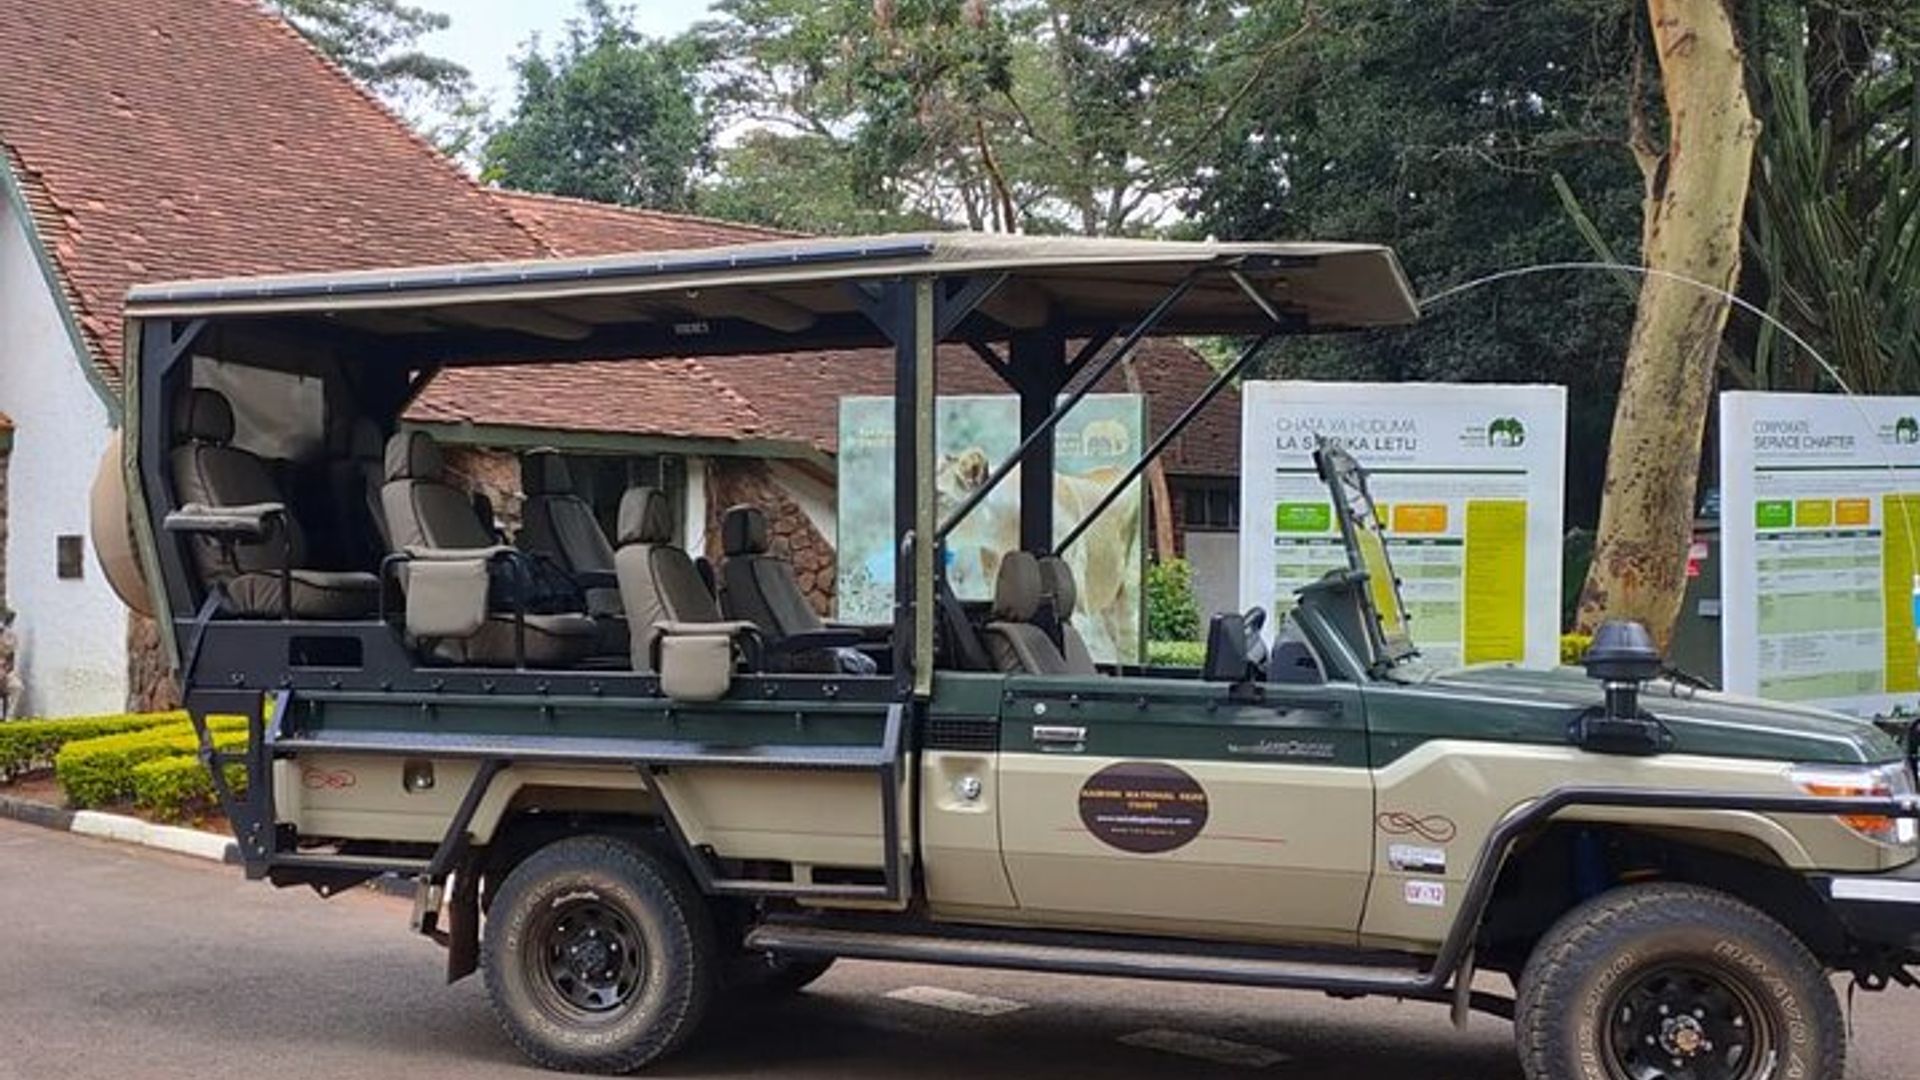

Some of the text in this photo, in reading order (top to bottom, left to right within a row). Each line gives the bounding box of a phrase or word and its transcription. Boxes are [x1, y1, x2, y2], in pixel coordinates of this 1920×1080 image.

[1350, 418, 1417, 434] HUDUMA
[1754, 419, 1811, 434] CORPORATE
[1275, 435, 1297, 450] LA
[1374, 436, 1417, 451] LETU
[1754, 434, 1855, 450] SERVICE CHARTER
